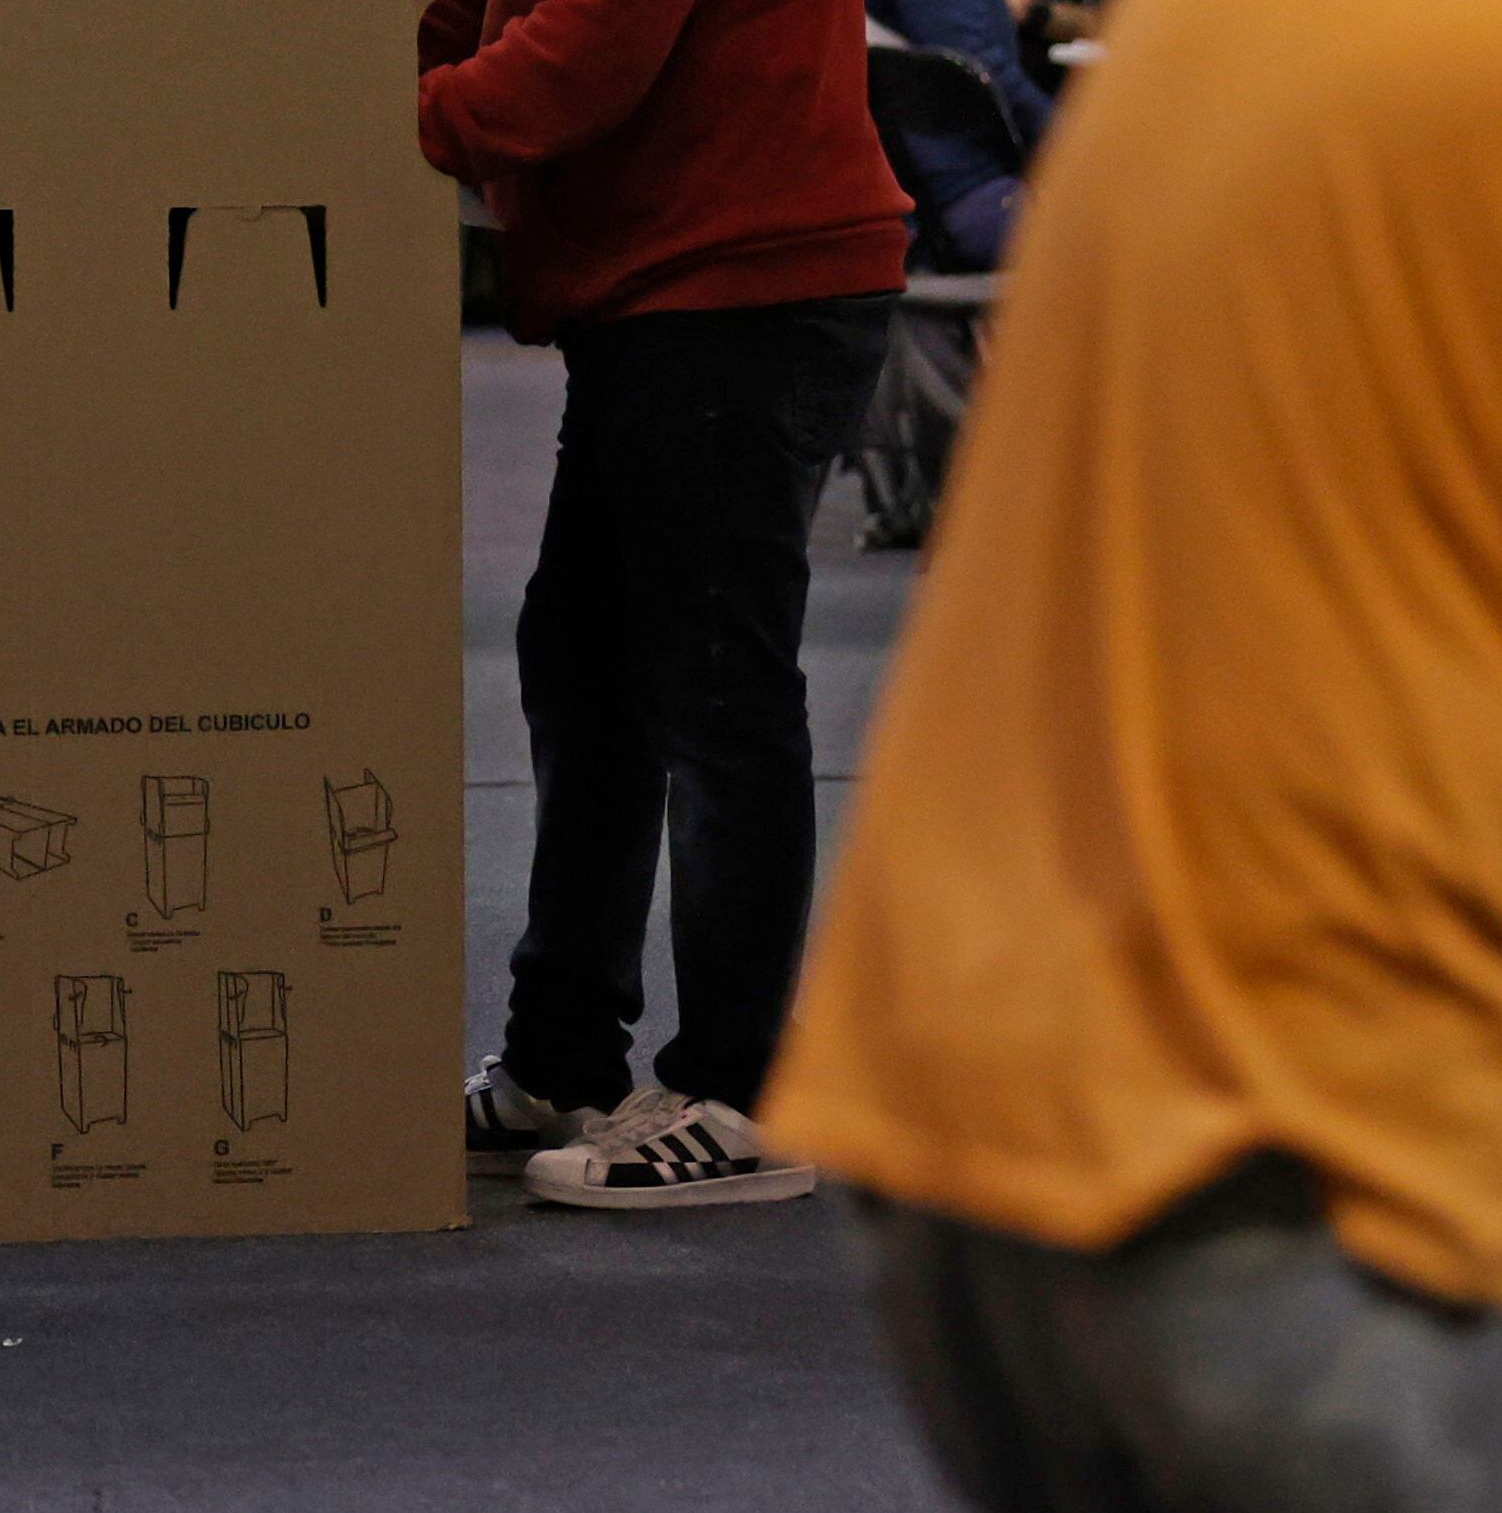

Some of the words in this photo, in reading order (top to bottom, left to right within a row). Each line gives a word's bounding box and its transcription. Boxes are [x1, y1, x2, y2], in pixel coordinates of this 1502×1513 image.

[12, 718, 40, 737] EL
[45, 716, 143, 735] ARMADO
[148, 715, 192, 734] DEL
[197, 712, 311, 732] CUBICULO
[125, 912, 139, 928] C
[319, 906, 333, 923] D
[51, 1143, 64, 1161] F
[213, 1139, 230, 1157] G
